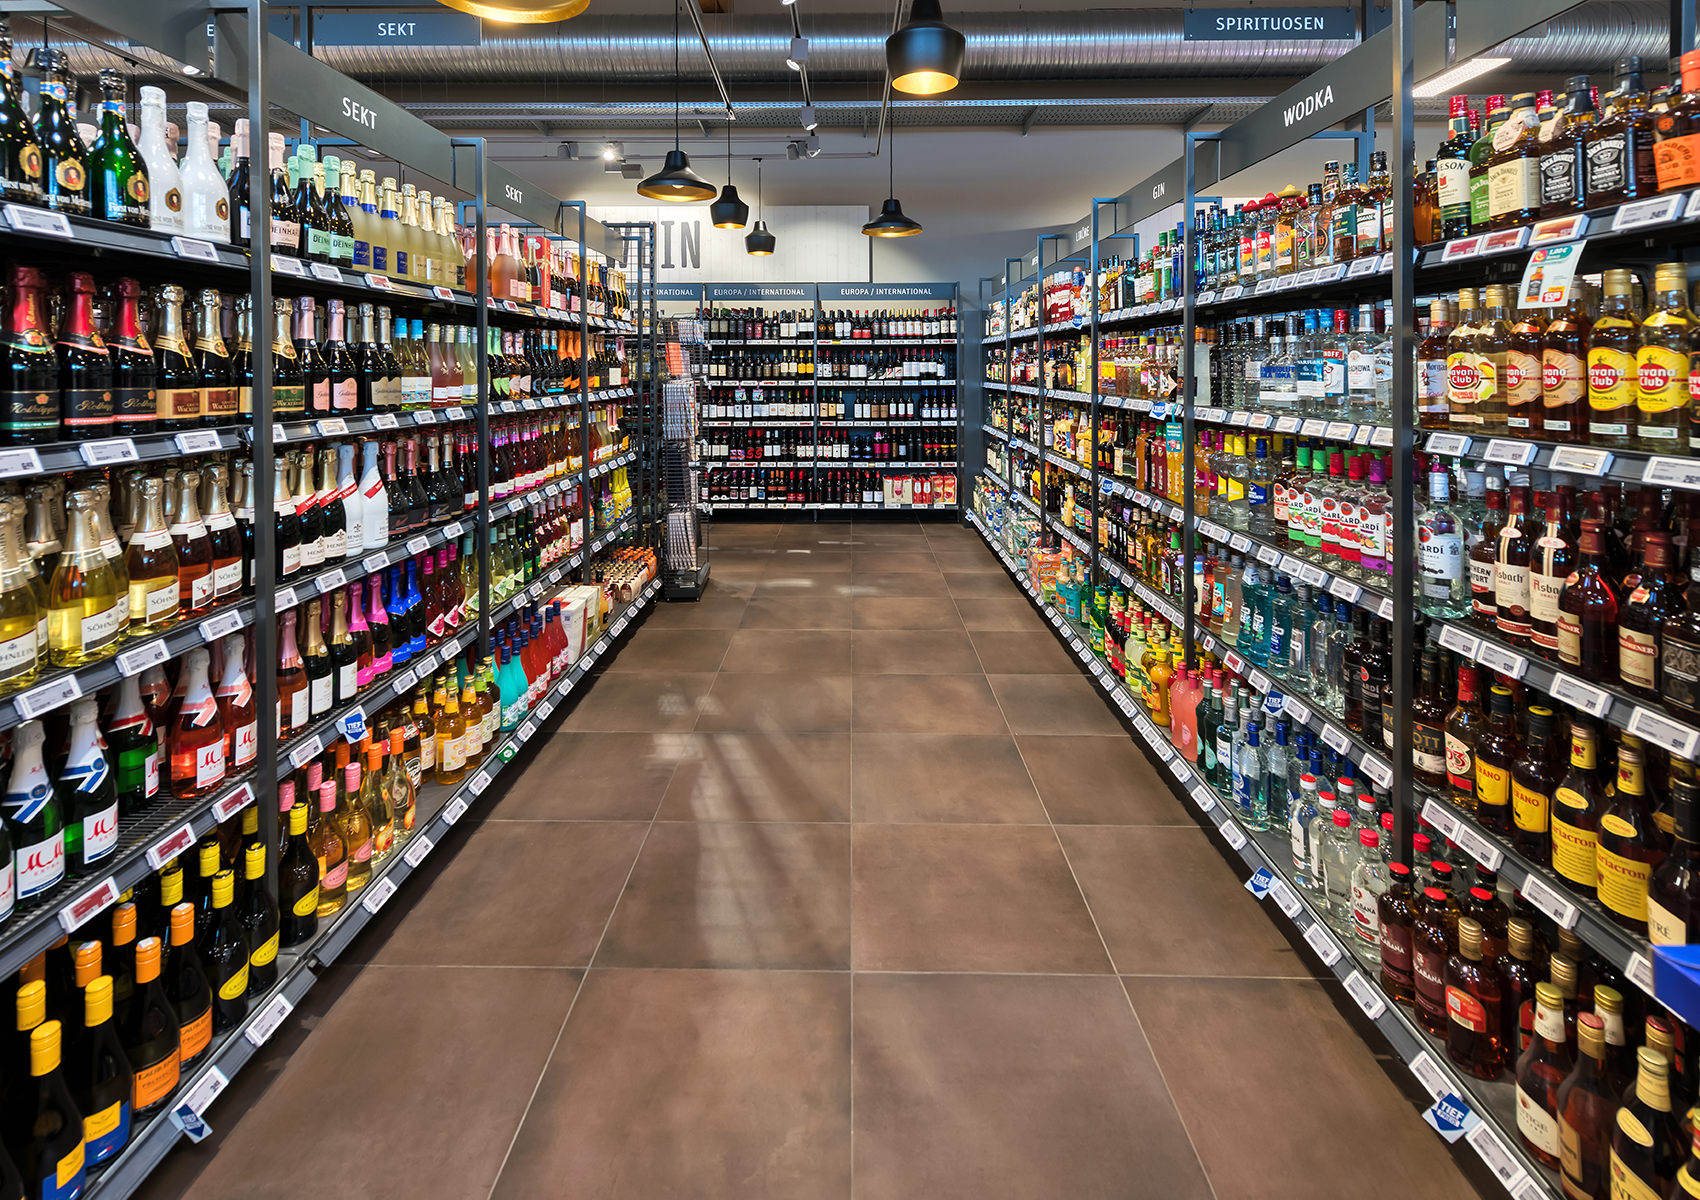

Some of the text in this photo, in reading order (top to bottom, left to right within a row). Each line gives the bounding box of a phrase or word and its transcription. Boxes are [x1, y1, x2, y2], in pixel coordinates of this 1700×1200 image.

[377, 22, 416, 36] SEKT
[1216, 17, 1324, 31] SPIRITUOSEN
[342, 96, 377, 130] SEKT
[1283, 85, 1334, 127] WODKA
[505, 184, 523, 204] SEKT
[1152, 182, 1165, 200] GIN
[714, 288, 743, 296] EUROPA
[749, 288, 805, 296] INTERNATIONAL
[841, 288, 869, 296] EUROPA
[876, 287, 932, 296] INTERNATIONAL
[1452, 375, 1472, 383] Club
[1591, 376, 1613, 386] Club
[1639, 376, 1664, 387] Club
[0, 647, 35, 662] HNLEIN
[346, 721, 361, 730] TIEF
[1413, 731, 1439, 750] OTT
[1441, 1100, 1465, 1120] TIEF
